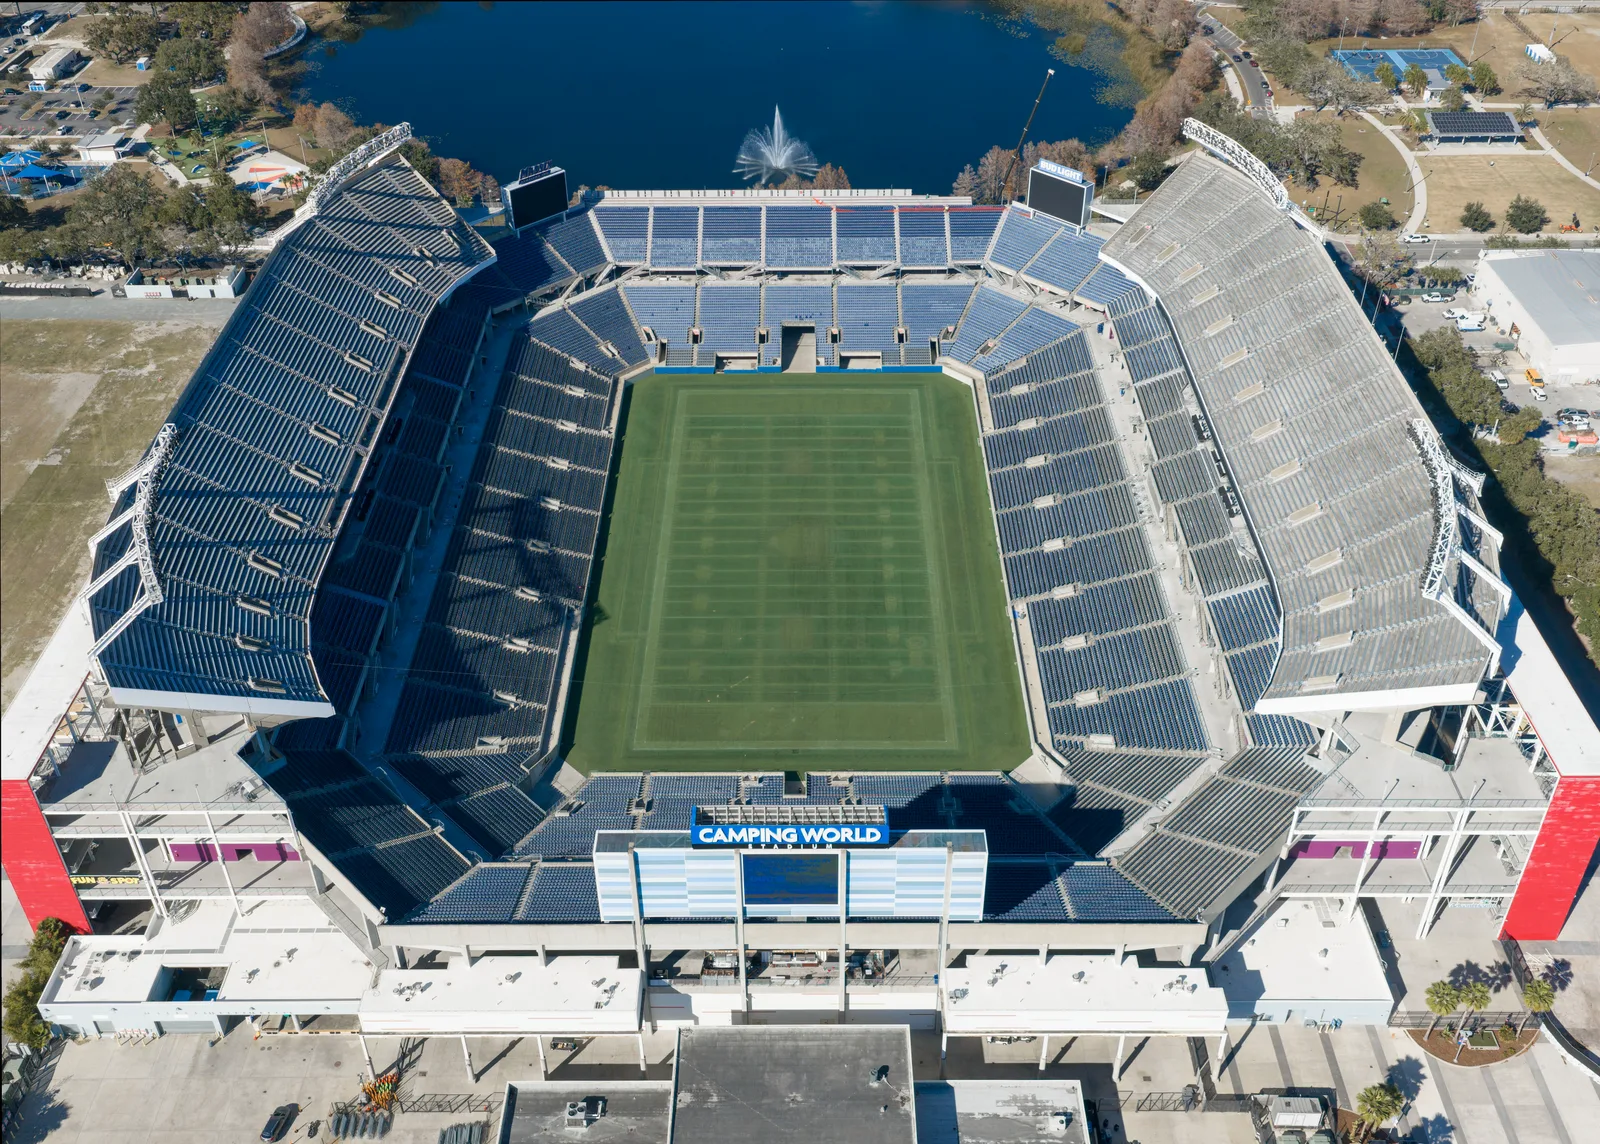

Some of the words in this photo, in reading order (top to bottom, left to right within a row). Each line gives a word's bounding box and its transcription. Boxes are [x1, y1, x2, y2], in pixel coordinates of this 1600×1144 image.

[699, 827, 797, 843] CAMPING
[801, 827, 881, 843] WORLD
[110, 877, 139, 885] SPOT
